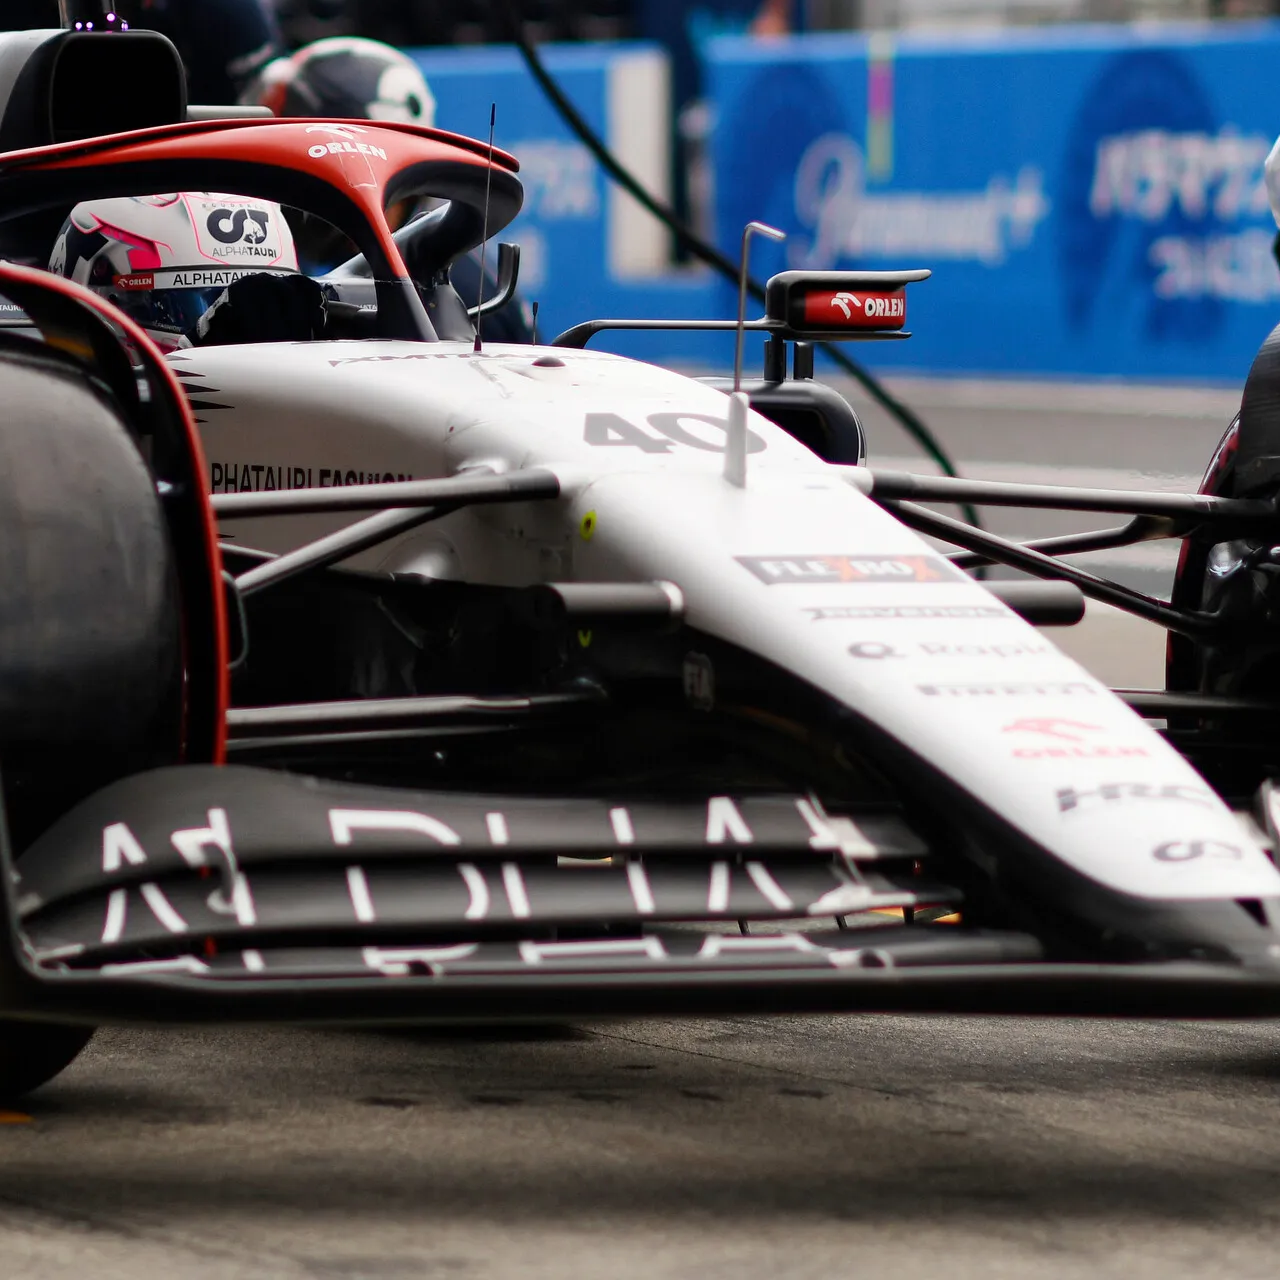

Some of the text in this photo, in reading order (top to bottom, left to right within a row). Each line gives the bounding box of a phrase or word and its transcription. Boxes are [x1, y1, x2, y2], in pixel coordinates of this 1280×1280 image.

[308, 140, 388, 161] ORLEN
[212, 246, 277, 259] ALPHATAURI
[128, 277, 153, 286] ORLEN
[173, 271, 262, 286] ALPHATA
[864, 295, 904, 317] ORLEN
[584, 412, 768, 454] 40
